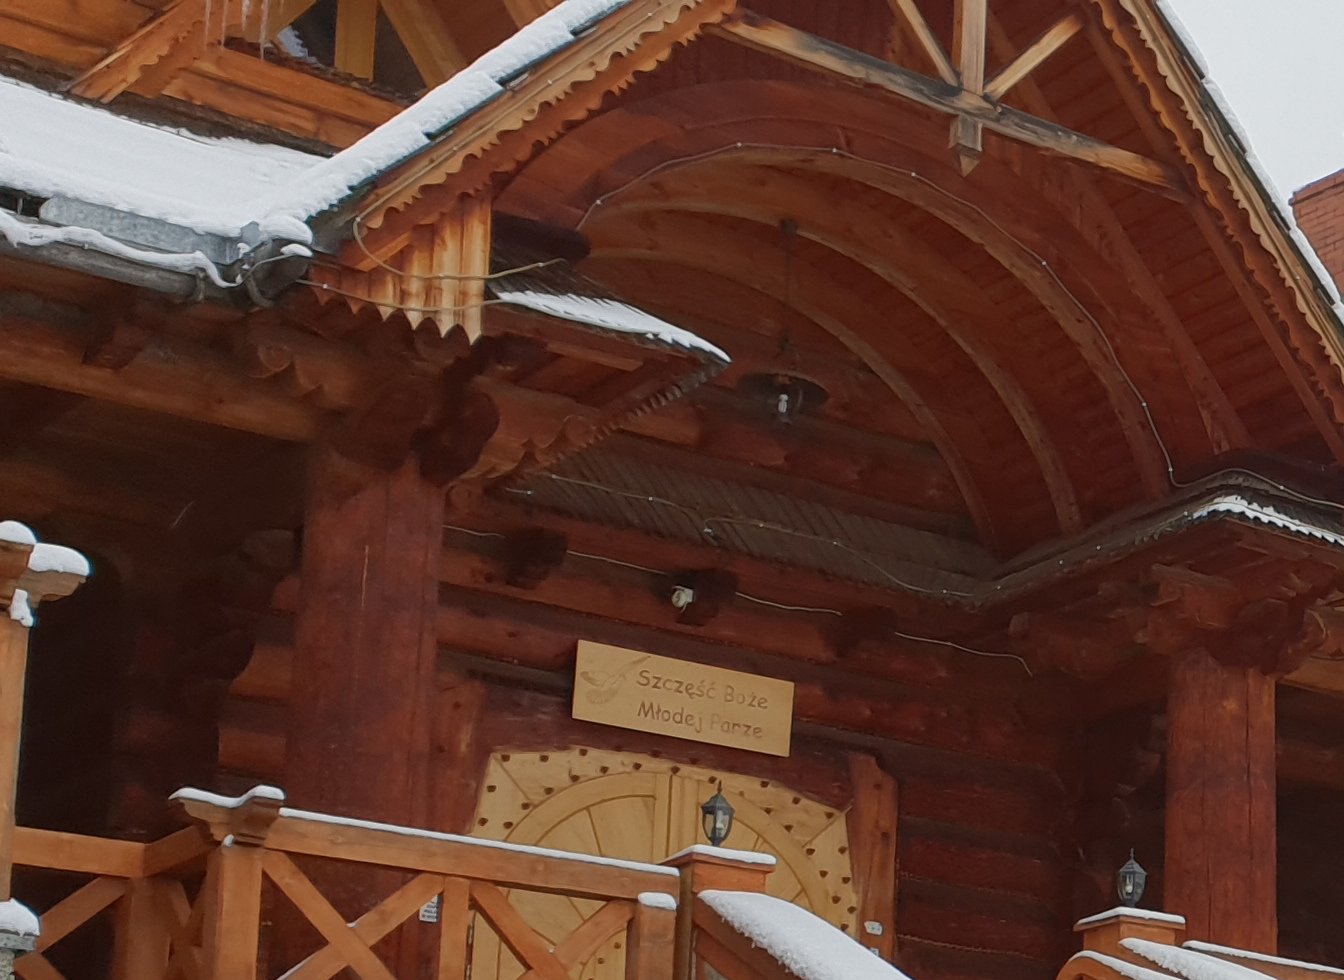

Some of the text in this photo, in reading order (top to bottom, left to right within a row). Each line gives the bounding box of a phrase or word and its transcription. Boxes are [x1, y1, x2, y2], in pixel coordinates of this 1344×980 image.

[636, 668, 769, 710] Szczęść Boże
[637, 701, 703, 733] Młodej
